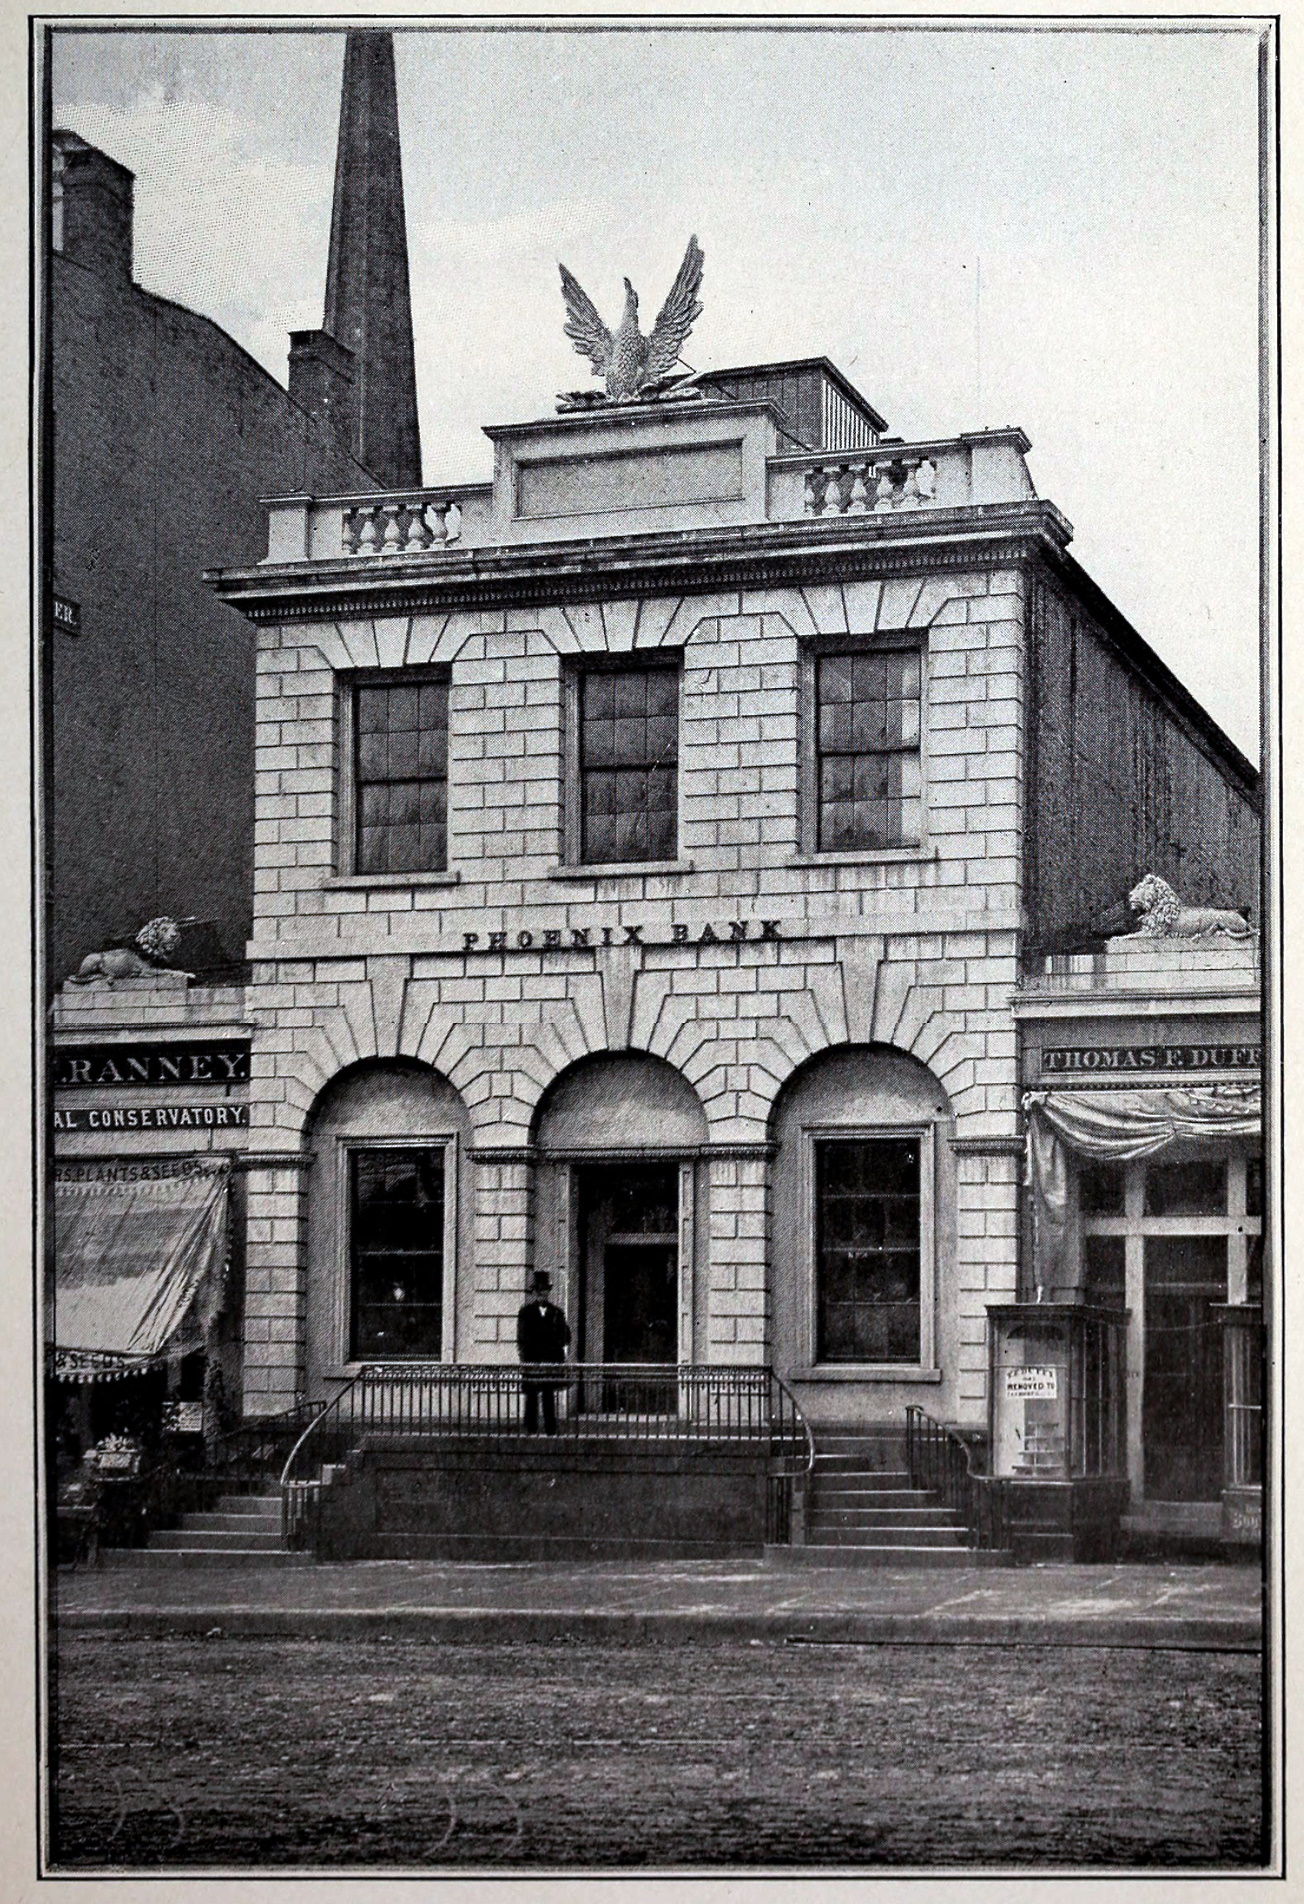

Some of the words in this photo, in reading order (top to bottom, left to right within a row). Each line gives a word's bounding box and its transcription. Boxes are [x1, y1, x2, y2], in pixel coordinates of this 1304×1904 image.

[462, 925, 643, 950] PHOENIX
[671, 920, 781, 943] BANK
[1043, 1050, 1155, 1068] THOMAS
[1165, 1050, 1183, 1066] F.
[54, 1109, 77, 1128] AL
[89, 1106, 246, 1128] CONSERVATORY.
